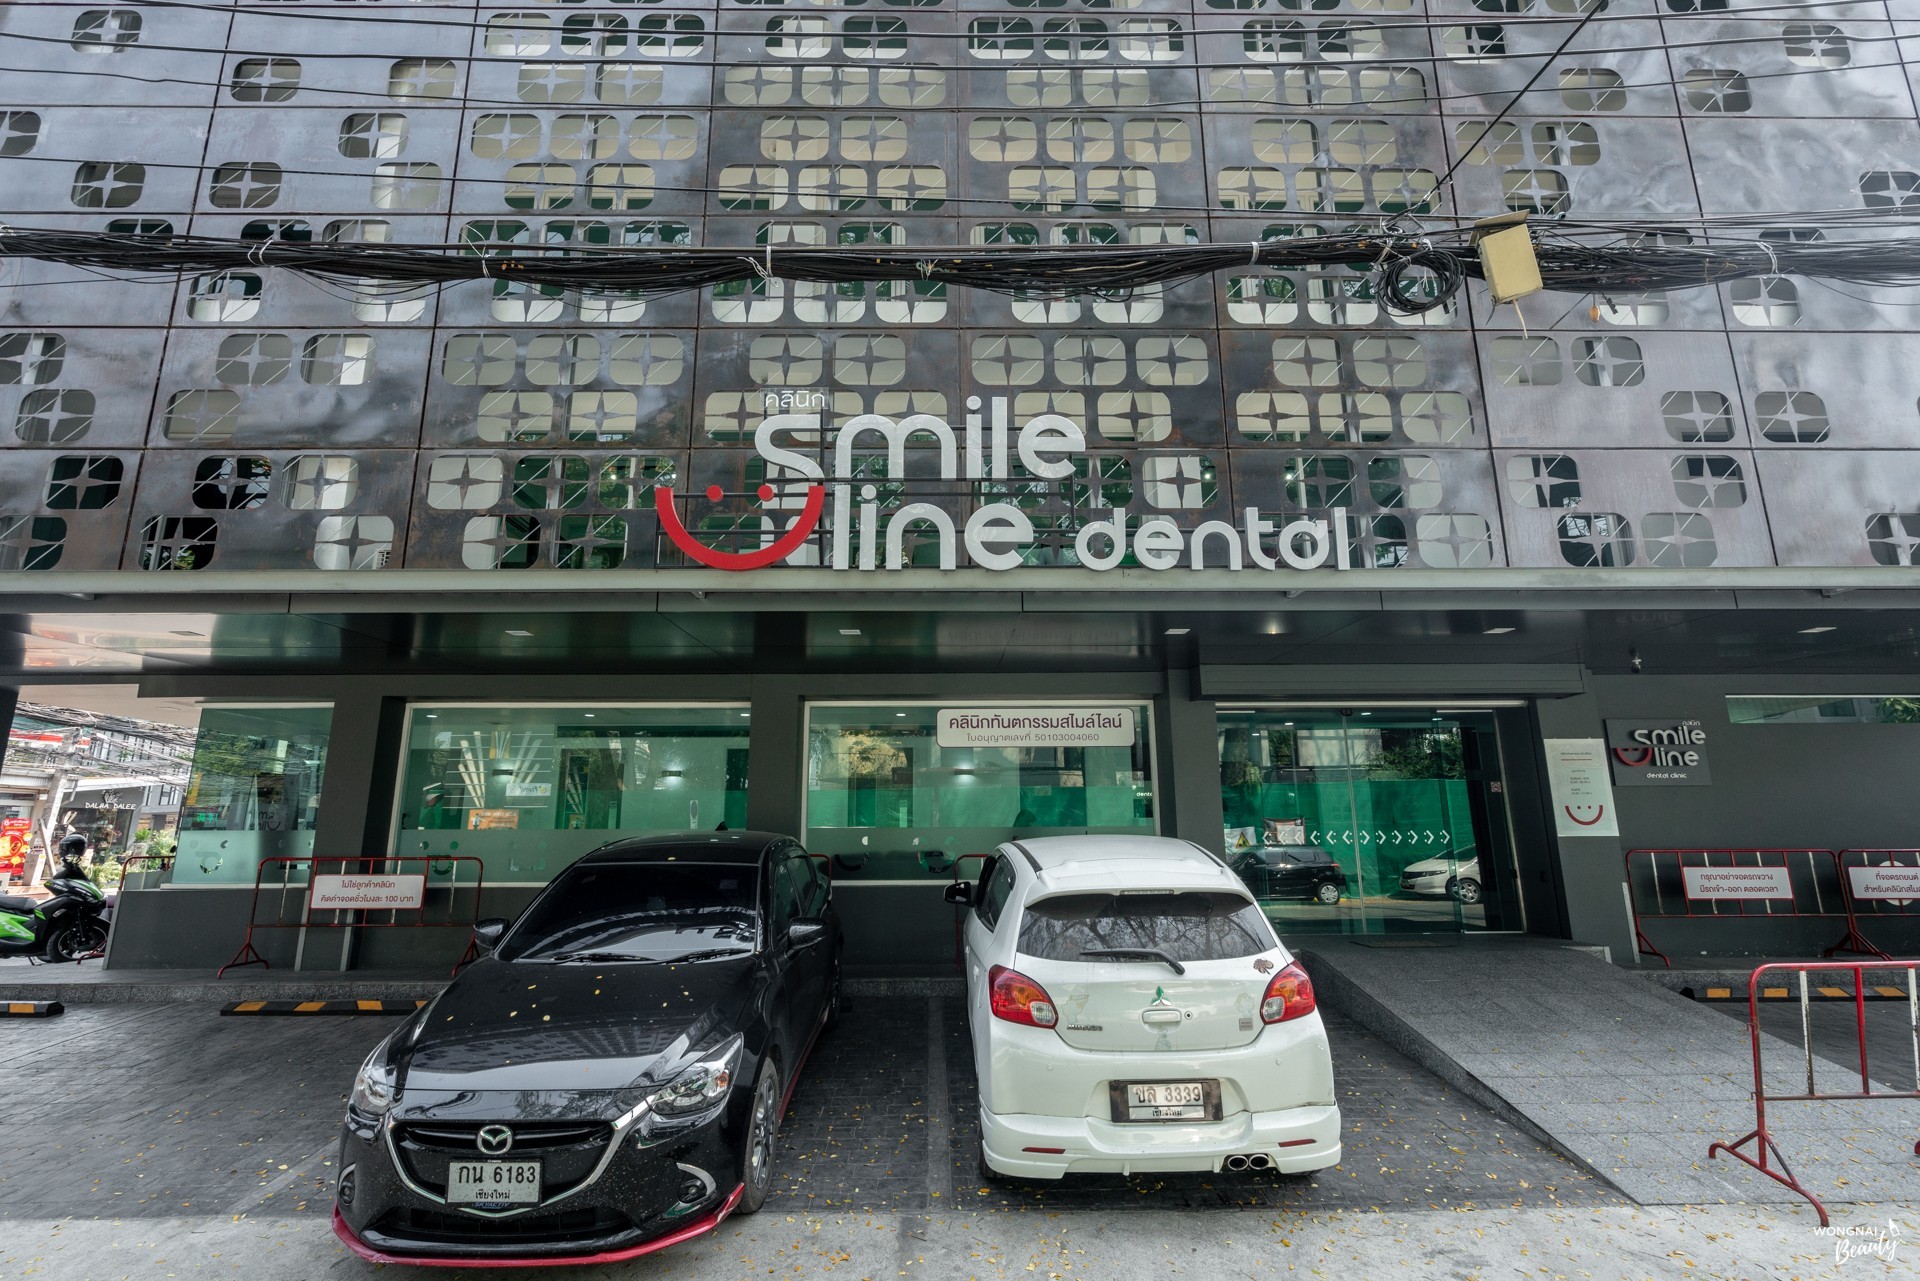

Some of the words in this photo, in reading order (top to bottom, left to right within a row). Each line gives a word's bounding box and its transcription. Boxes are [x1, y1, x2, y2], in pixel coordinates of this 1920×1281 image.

[765, 390, 825, 408] คลินิก
[755, 396, 1087, 481] smile
[833, 484, 1035, 571] line
[1074, 506, 1351, 571] dental
[949, 713, 1122, 729] คลินิกทันตกรรมสไมล์ไลน์
[967, 731, 1031, 743] ใบอนุญาตเลขที่
[1034, 733, 1100, 742] 50103004060
[1633, 725, 1706, 745] smile
[1654, 747, 1699, 766] line
[341, 880, 395, 890] ไม่ใช่ลูกค้าคลินิก
[1700, 872, 1774, 882] กรุณาอย่าจอดรถขวาง
[1743, 885, 1778, 893] ตลอดเวลา
[1164, 1086, 1201, 1102] 3339
[458, 1165, 484, 1184] กน
[493, 1165, 536, 1184] 6183
[475, 1189, 511, 1199] เชียงใหม่
